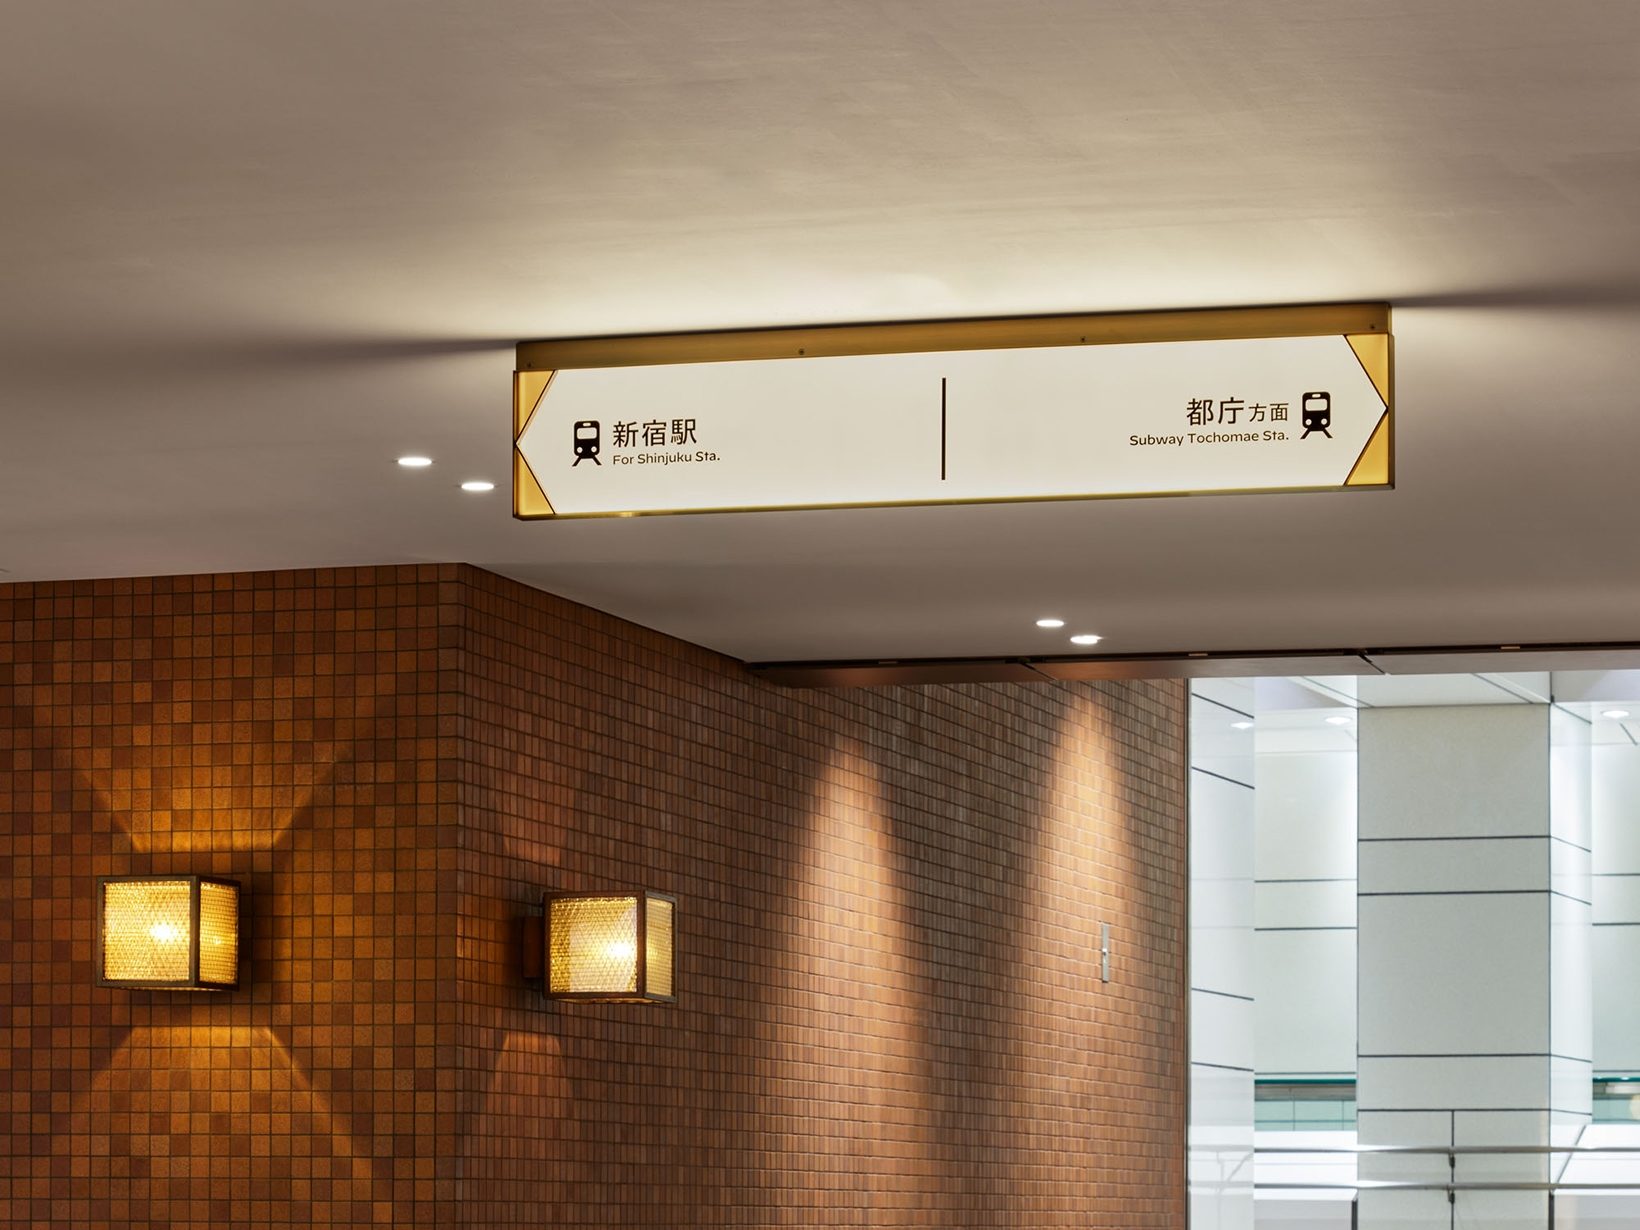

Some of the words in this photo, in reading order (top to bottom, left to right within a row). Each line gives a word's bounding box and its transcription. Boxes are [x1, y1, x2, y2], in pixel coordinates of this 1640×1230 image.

[1186, 396, 1290, 427] 都庁方面
[612, 418, 698, 449] 新宿駅
[1129, 434, 1185, 447] Subway
[1187, 431, 1260, 444] Tochomae
[1262, 430, 1290, 442] Sta.
[612, 454, 635, 466] For
[637, 451, 692, 466] Shinjuku
[694, 450, 721, 463] Sta.
